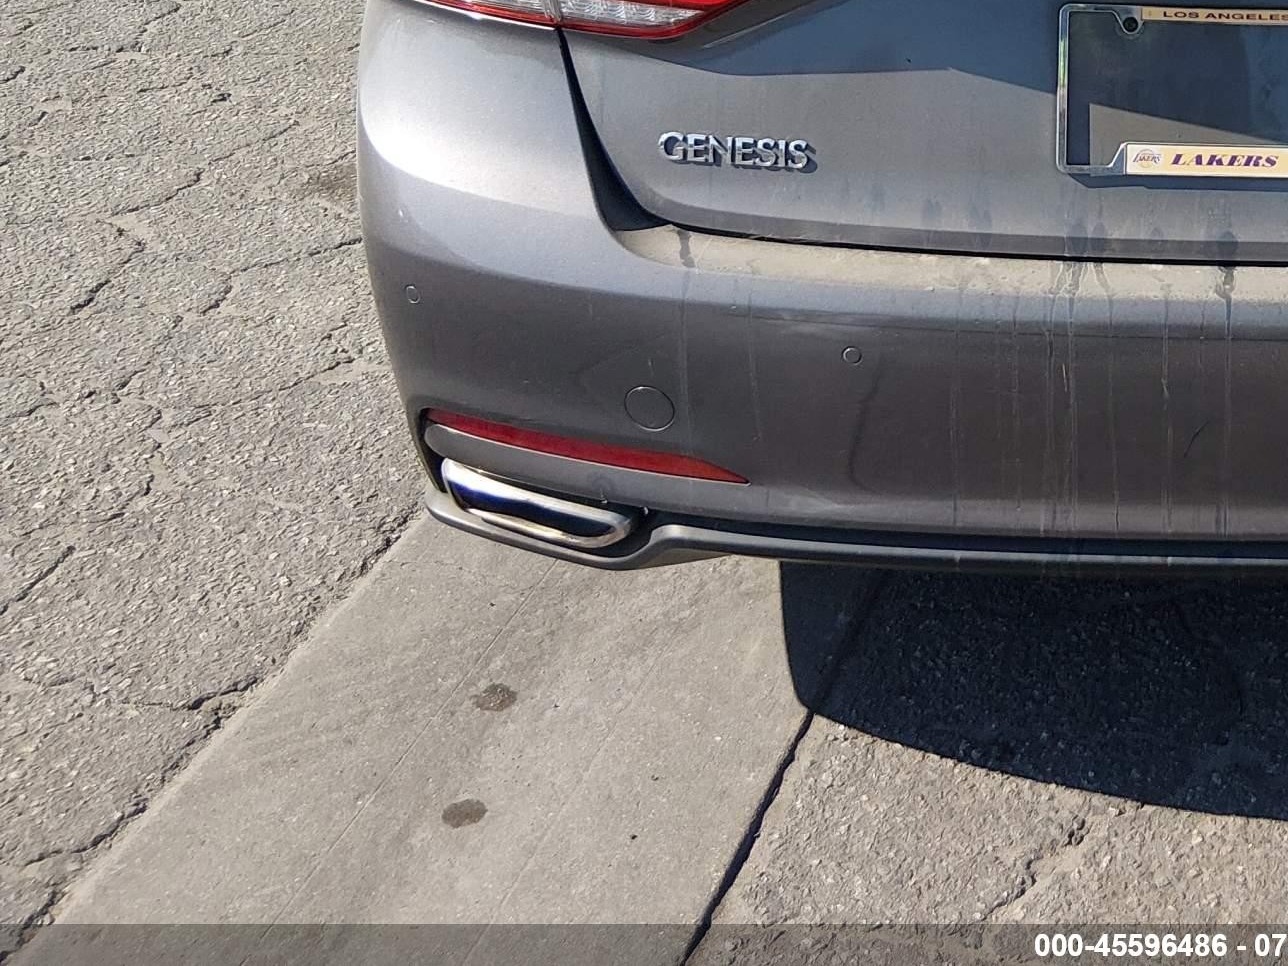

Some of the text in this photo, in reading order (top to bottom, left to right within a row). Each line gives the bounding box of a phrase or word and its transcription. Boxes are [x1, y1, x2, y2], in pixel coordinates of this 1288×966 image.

[1163, 11, 1199, 19] LOS
[658, 131, 809, 169] GENESIS
[1132, 151, 1162, 164] LAKERS
[1171, 153, 1279, 168] LAKERS
